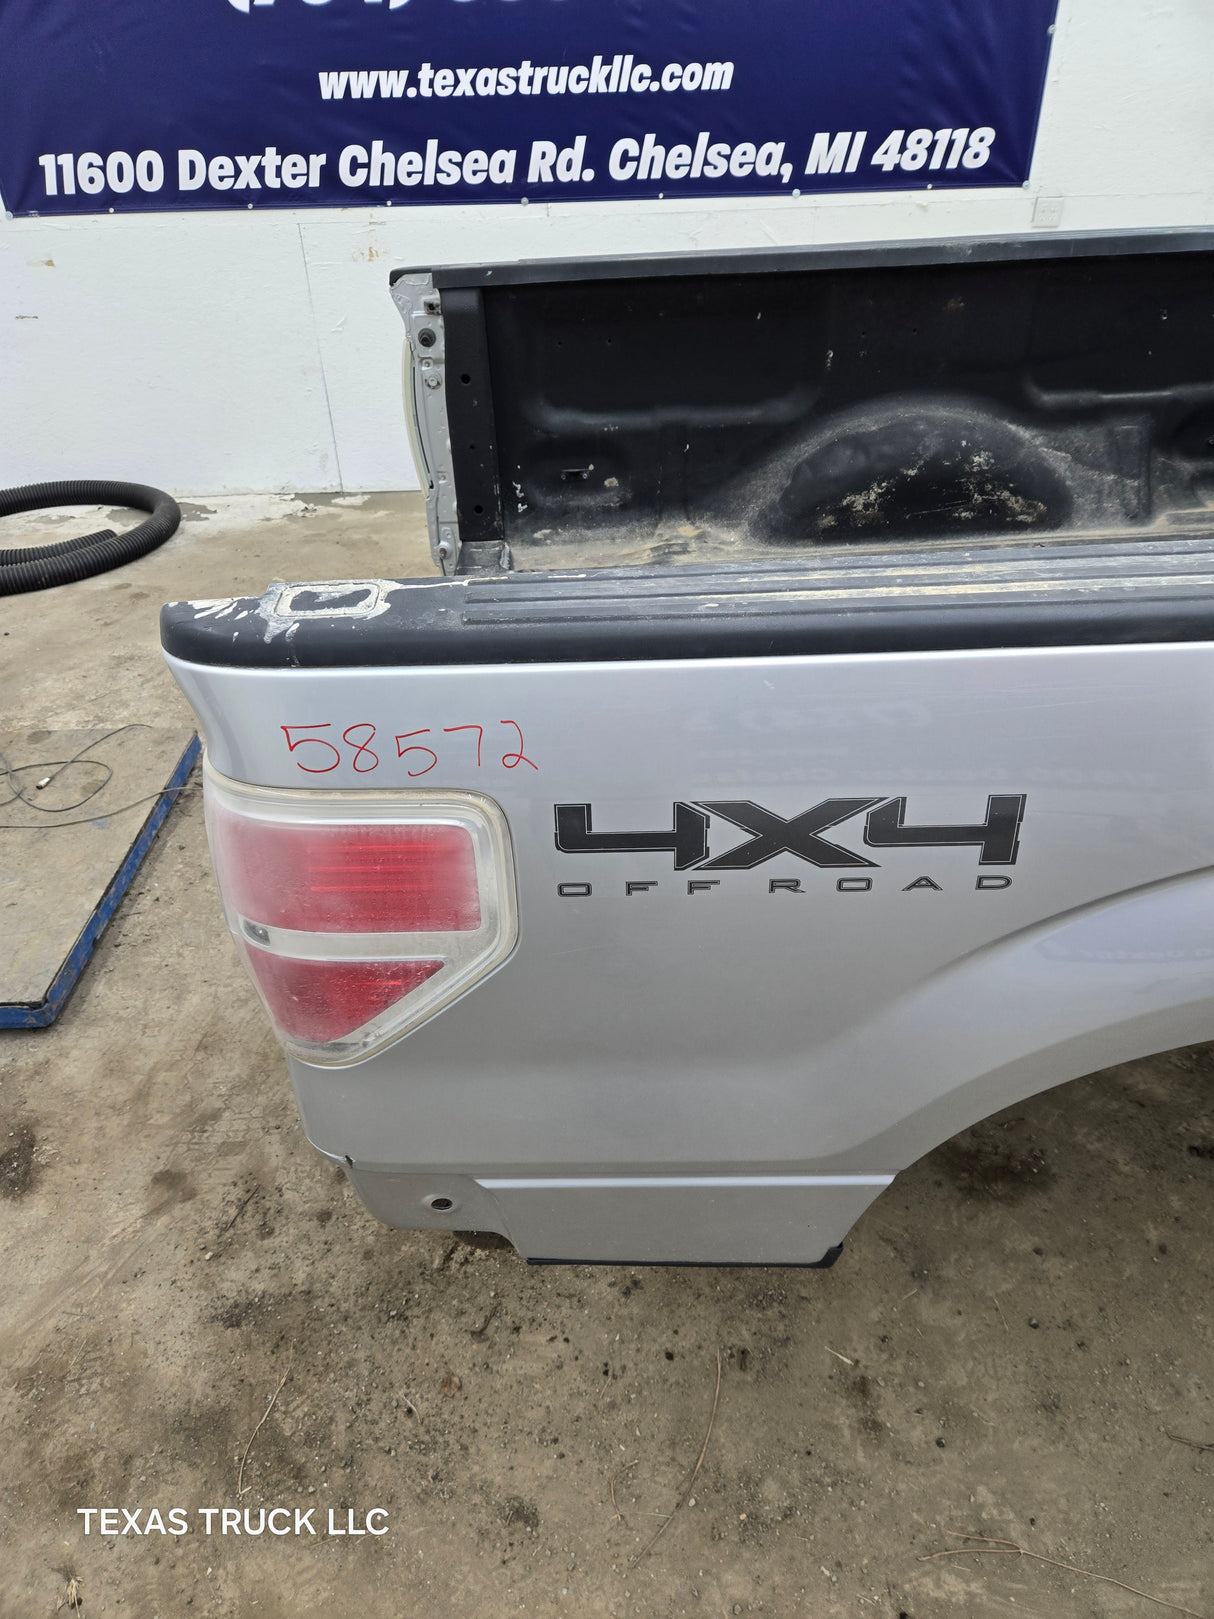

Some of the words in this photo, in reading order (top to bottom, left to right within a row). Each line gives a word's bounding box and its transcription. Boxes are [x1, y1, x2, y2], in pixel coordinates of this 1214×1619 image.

[319, 55, 735, 100] www.texastruckllc.com
[38, 149, 165, 196] 11600
[178, 146, 327, 192] Dexter
[338, 138, 517, 188] Chelsea
[527, 135, 595, 183] Rd.
[608, 130, 793, 184] Chelsea,
[804, 131, 868, 175] MI
[870, 126, 996, 172] 48118
[280, 720, 539, 777] 58572
[557, 879, 721, 898] OFF
[768, 874, 1014, 895] ROAD
